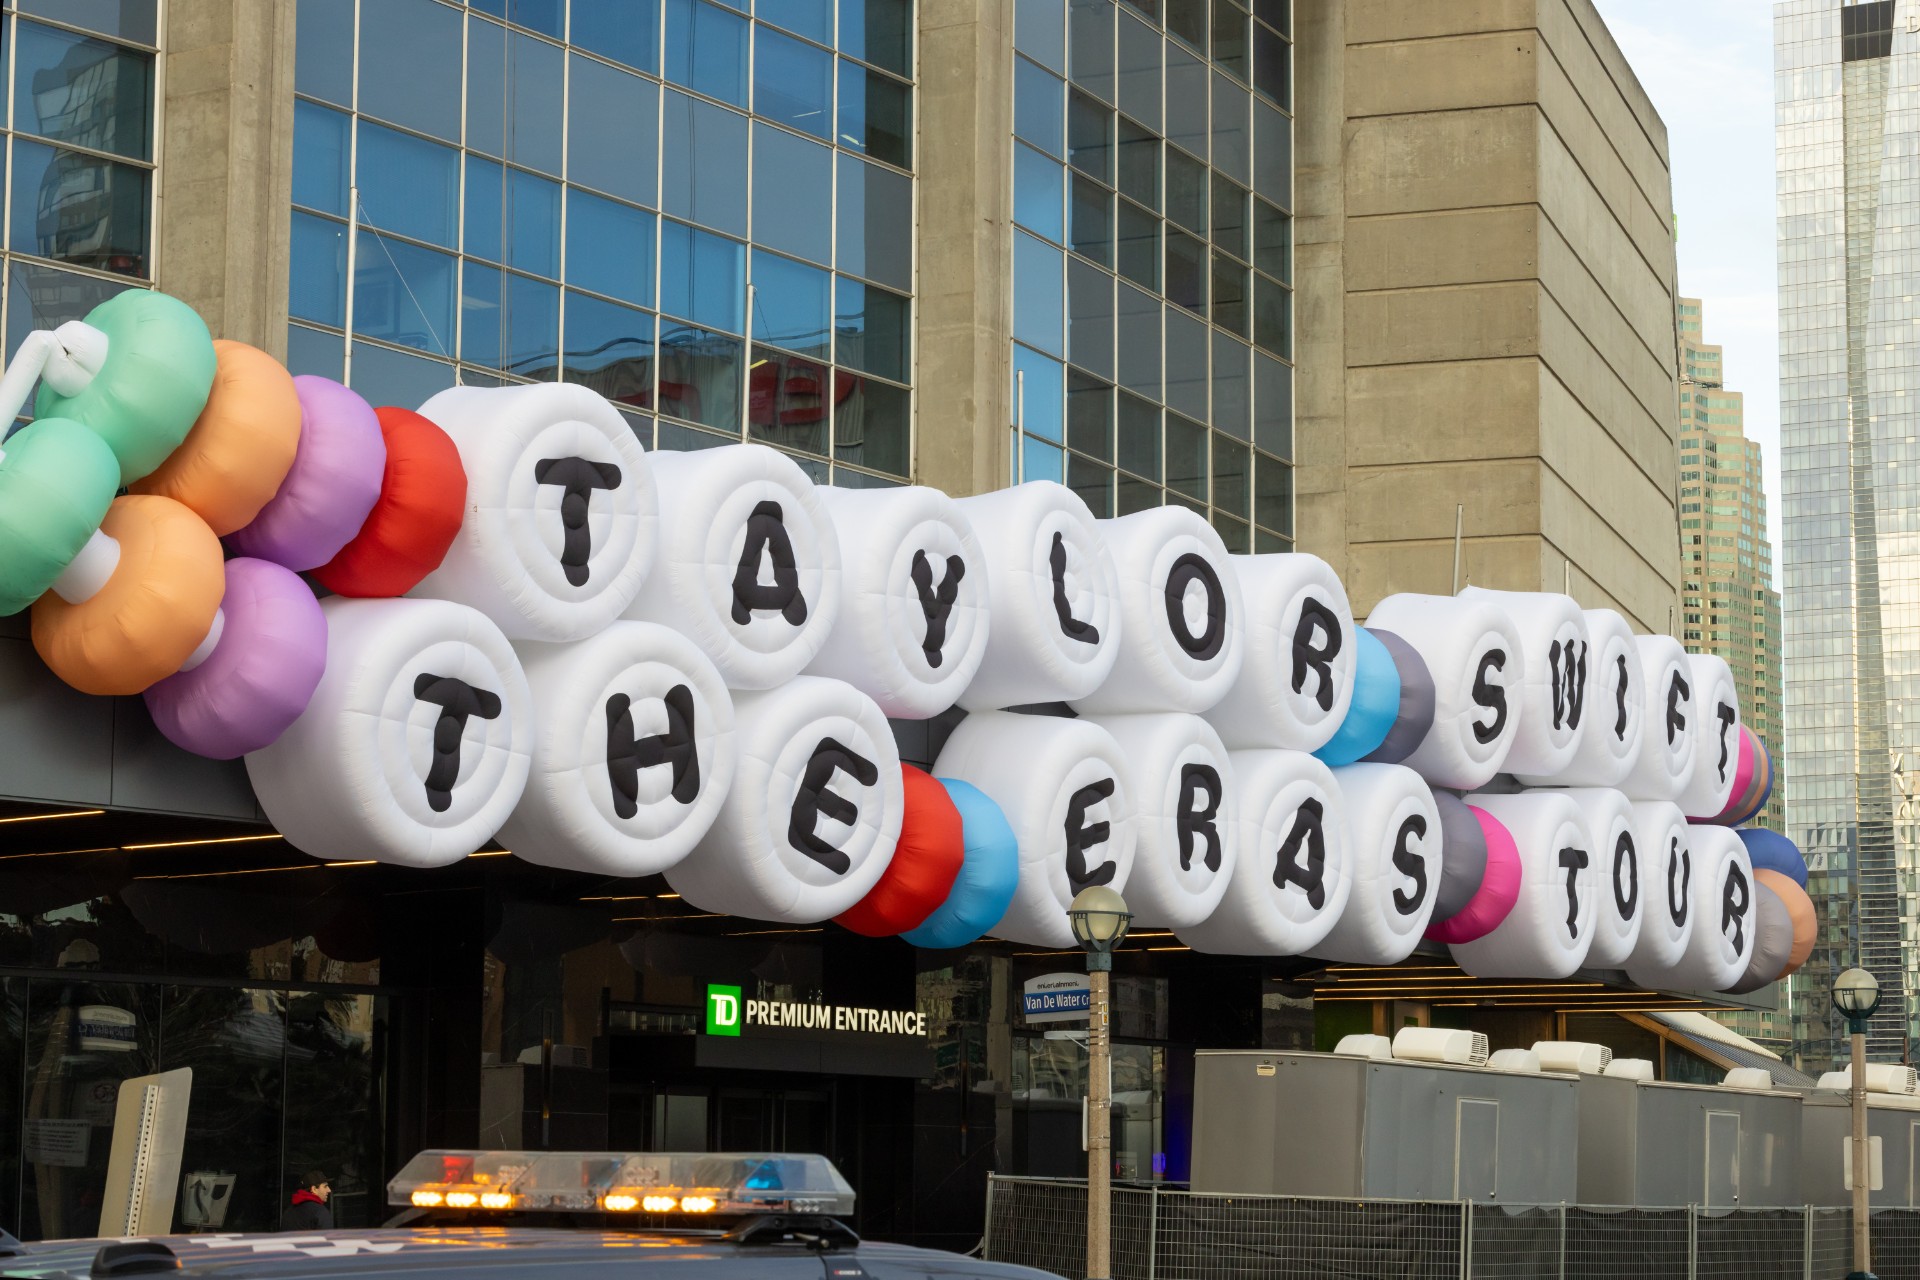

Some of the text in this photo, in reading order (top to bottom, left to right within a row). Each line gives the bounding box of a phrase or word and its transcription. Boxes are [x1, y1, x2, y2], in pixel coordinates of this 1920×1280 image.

[535, 457, 1739, 785] TAYLOR SWIFT
[414, 673, 1749, 957] THE ERAS TOUR
[711, 995, 927, 1036] TD PREMIUM ENTRANCE
[1025, 997, 1042, 1010] Van
[1044, 995, 1055, 1008] De
[1056, 993, 1080, 1007] Water
